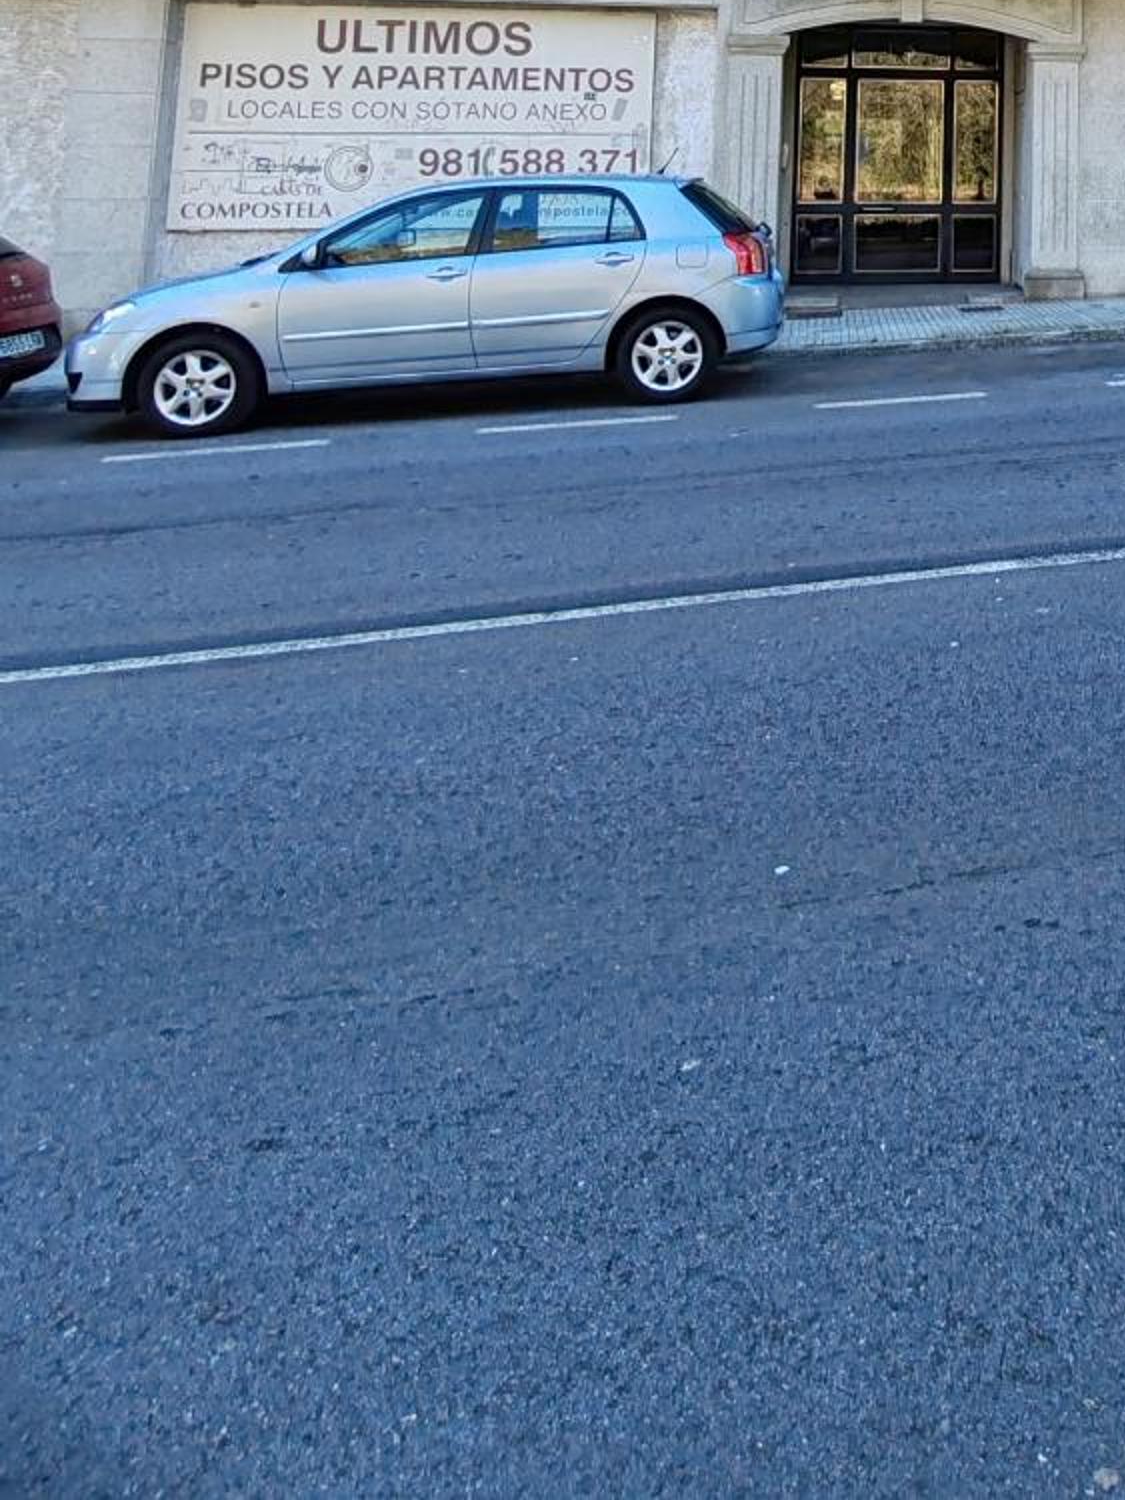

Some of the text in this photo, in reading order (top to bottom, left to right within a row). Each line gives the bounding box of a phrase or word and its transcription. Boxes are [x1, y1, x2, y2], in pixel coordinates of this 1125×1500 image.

[316, 19, 533, 56] ULTIMOS
[199, 62, 635, 93] PISOS Y APARTAMENTOS
[226, 99, 343, 119] LOCALES
[351, 100, 407, 119] CON
[524, 102, 607, 121] ANEXO
[418, 148, 640, 176] 981 588 371
[180, 201, 333, 220] COMPOSTELA
